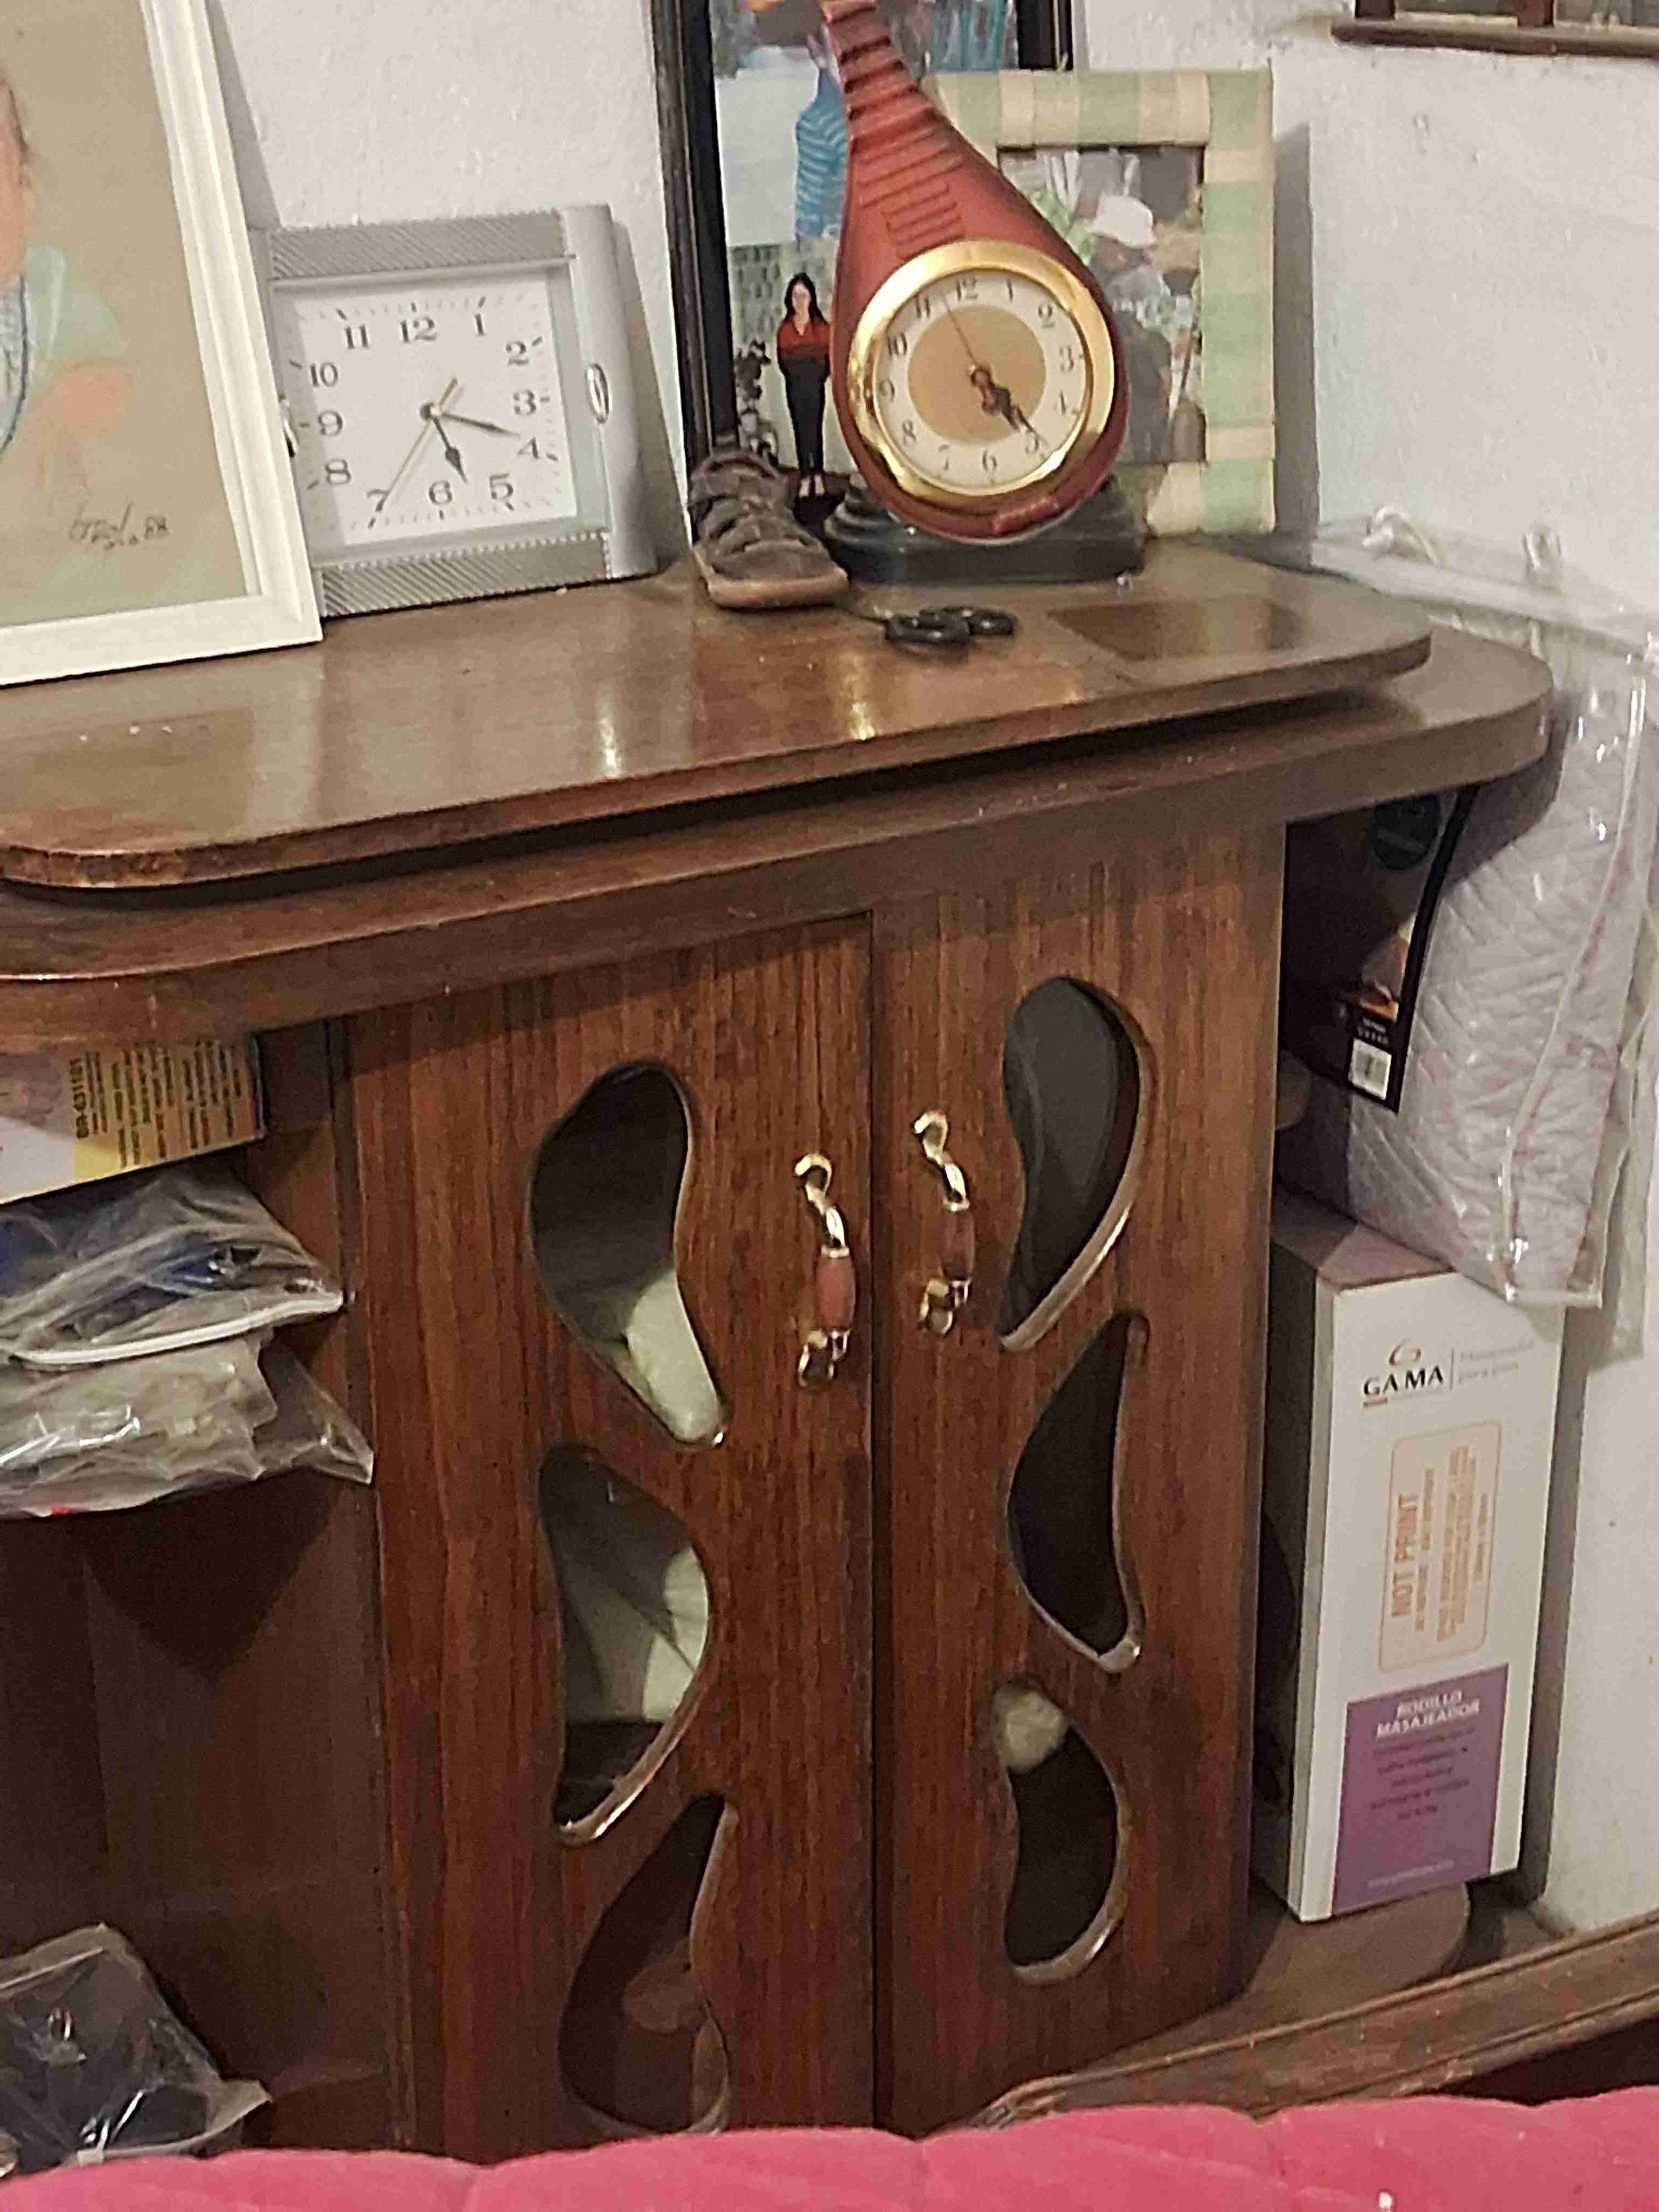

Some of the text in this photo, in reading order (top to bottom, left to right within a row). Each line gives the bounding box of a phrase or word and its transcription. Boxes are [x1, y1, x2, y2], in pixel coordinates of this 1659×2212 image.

[956, 279, 978, 301] 12
[1007, 280, 1013, 301] 1
[916, 297, 930, 318] 11
[1038, 304, 1054, 327] 2
[345, 325, 370, 349] 11
[401, 317, 436, 343] 12
[475, 314, 484, 336] 1
[506, 340, 529, 365] 2
[886, 333, 907, 356] 10
[1059, 346, 1074, 372] 3
[310, 362, 338, 387] 10
[879, 378, 895, 401] 9
[513, 390, 536, 415] 3
[1053, 390, 1066, 415] 4
[317, 410, 343, 436] 9
[902, 420, 917, 445] 8
[517, 437, 539, 459] 4
[938, 445, 950, 470] 7
[325, 459, 351, 485] 8
[982, 450, 997, 473] 6
[429, 480, 452, 505] 6
[489, 473, 513, 502] 5
[367, 489, 391, 512] 7
[1363, 1366, 1443, 1397] GAMA
